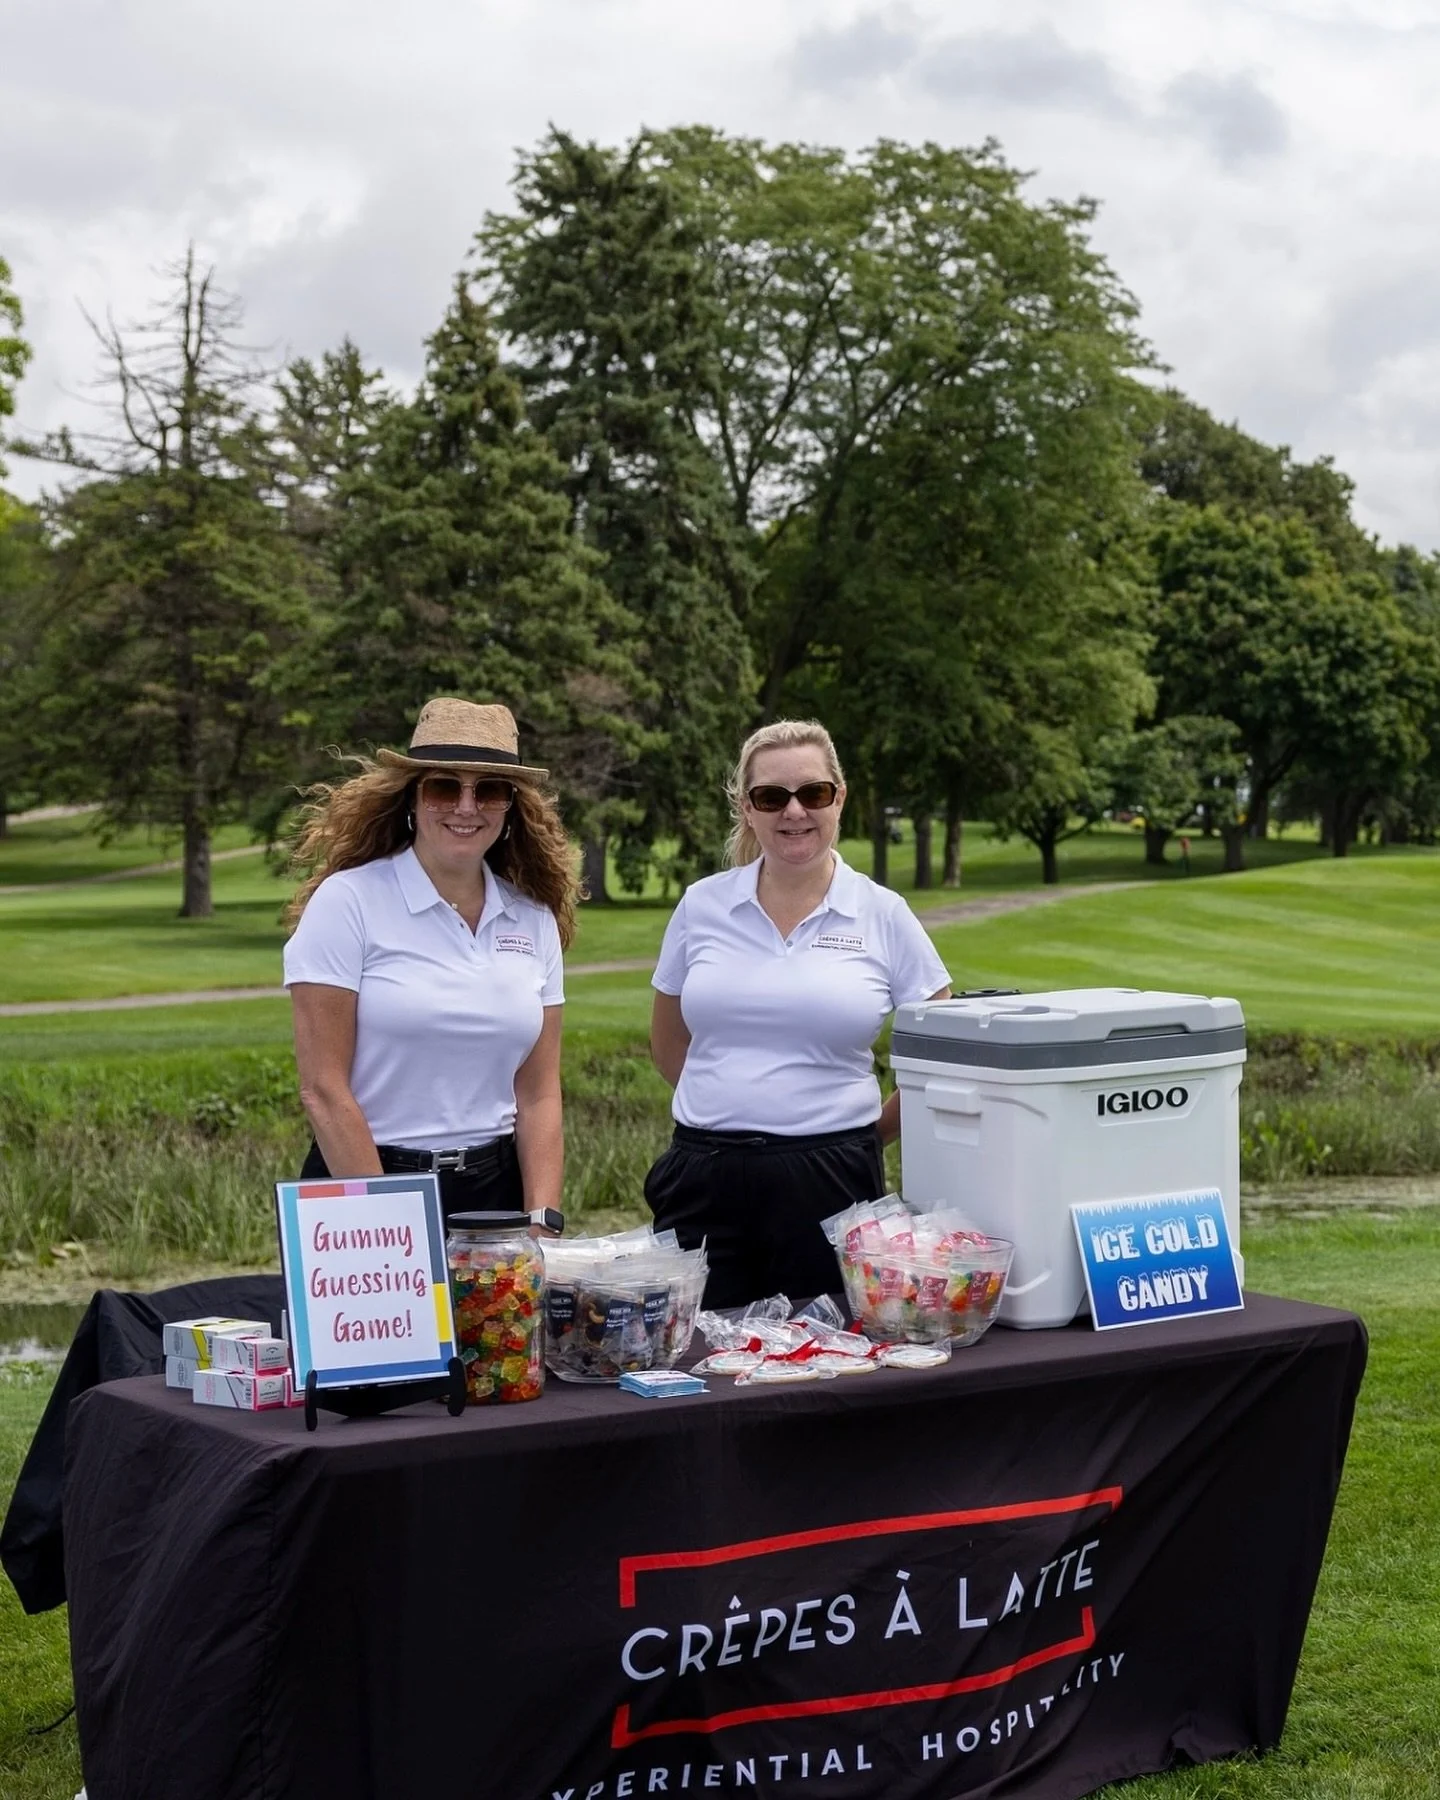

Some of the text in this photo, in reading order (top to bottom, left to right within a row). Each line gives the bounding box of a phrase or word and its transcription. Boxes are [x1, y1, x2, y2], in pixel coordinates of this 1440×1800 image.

[1097, 1087, 1189, 1116] IGLOO
[313, 1221, 414, 1258] Gummy
[1090, 1213, 1220, 1264] ICE COLD
[310, 1263, 427, 1298] Guessing
[1117, 1265, 1209, 1312] CANDY
[333, 1309, 413, 1344] Game!
[621, 1539, 1101, 1681] CRÊPES À LATTE
[922, 1652, 1125, 1761] HOSPITLITY
